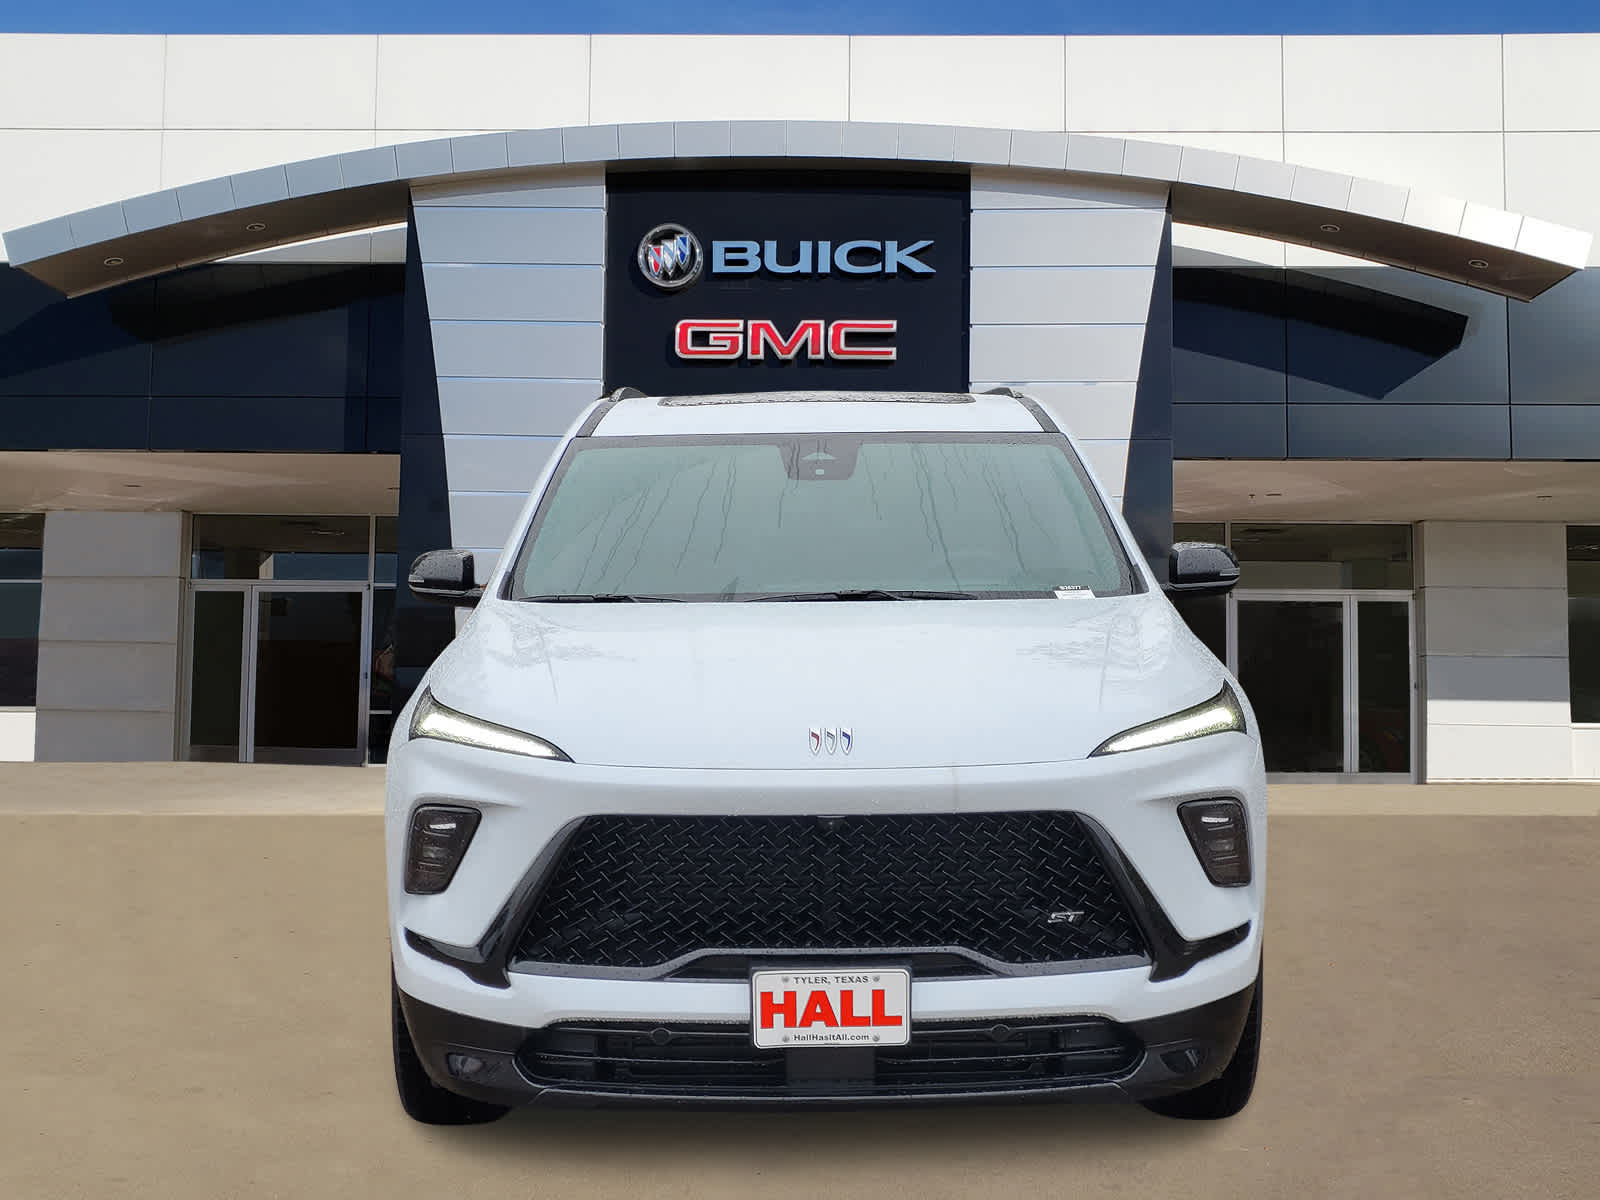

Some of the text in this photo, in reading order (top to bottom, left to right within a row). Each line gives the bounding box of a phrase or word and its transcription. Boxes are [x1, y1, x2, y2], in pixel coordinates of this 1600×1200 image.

[712, 240, 937, 273] BUICK
[675, 319, 898, 361] GMC
[1047, 911, 1085, 924] ST
[793, 975, 869, 985] TYLER, TEXAS
[760, 988, 903, 1030] HALL
